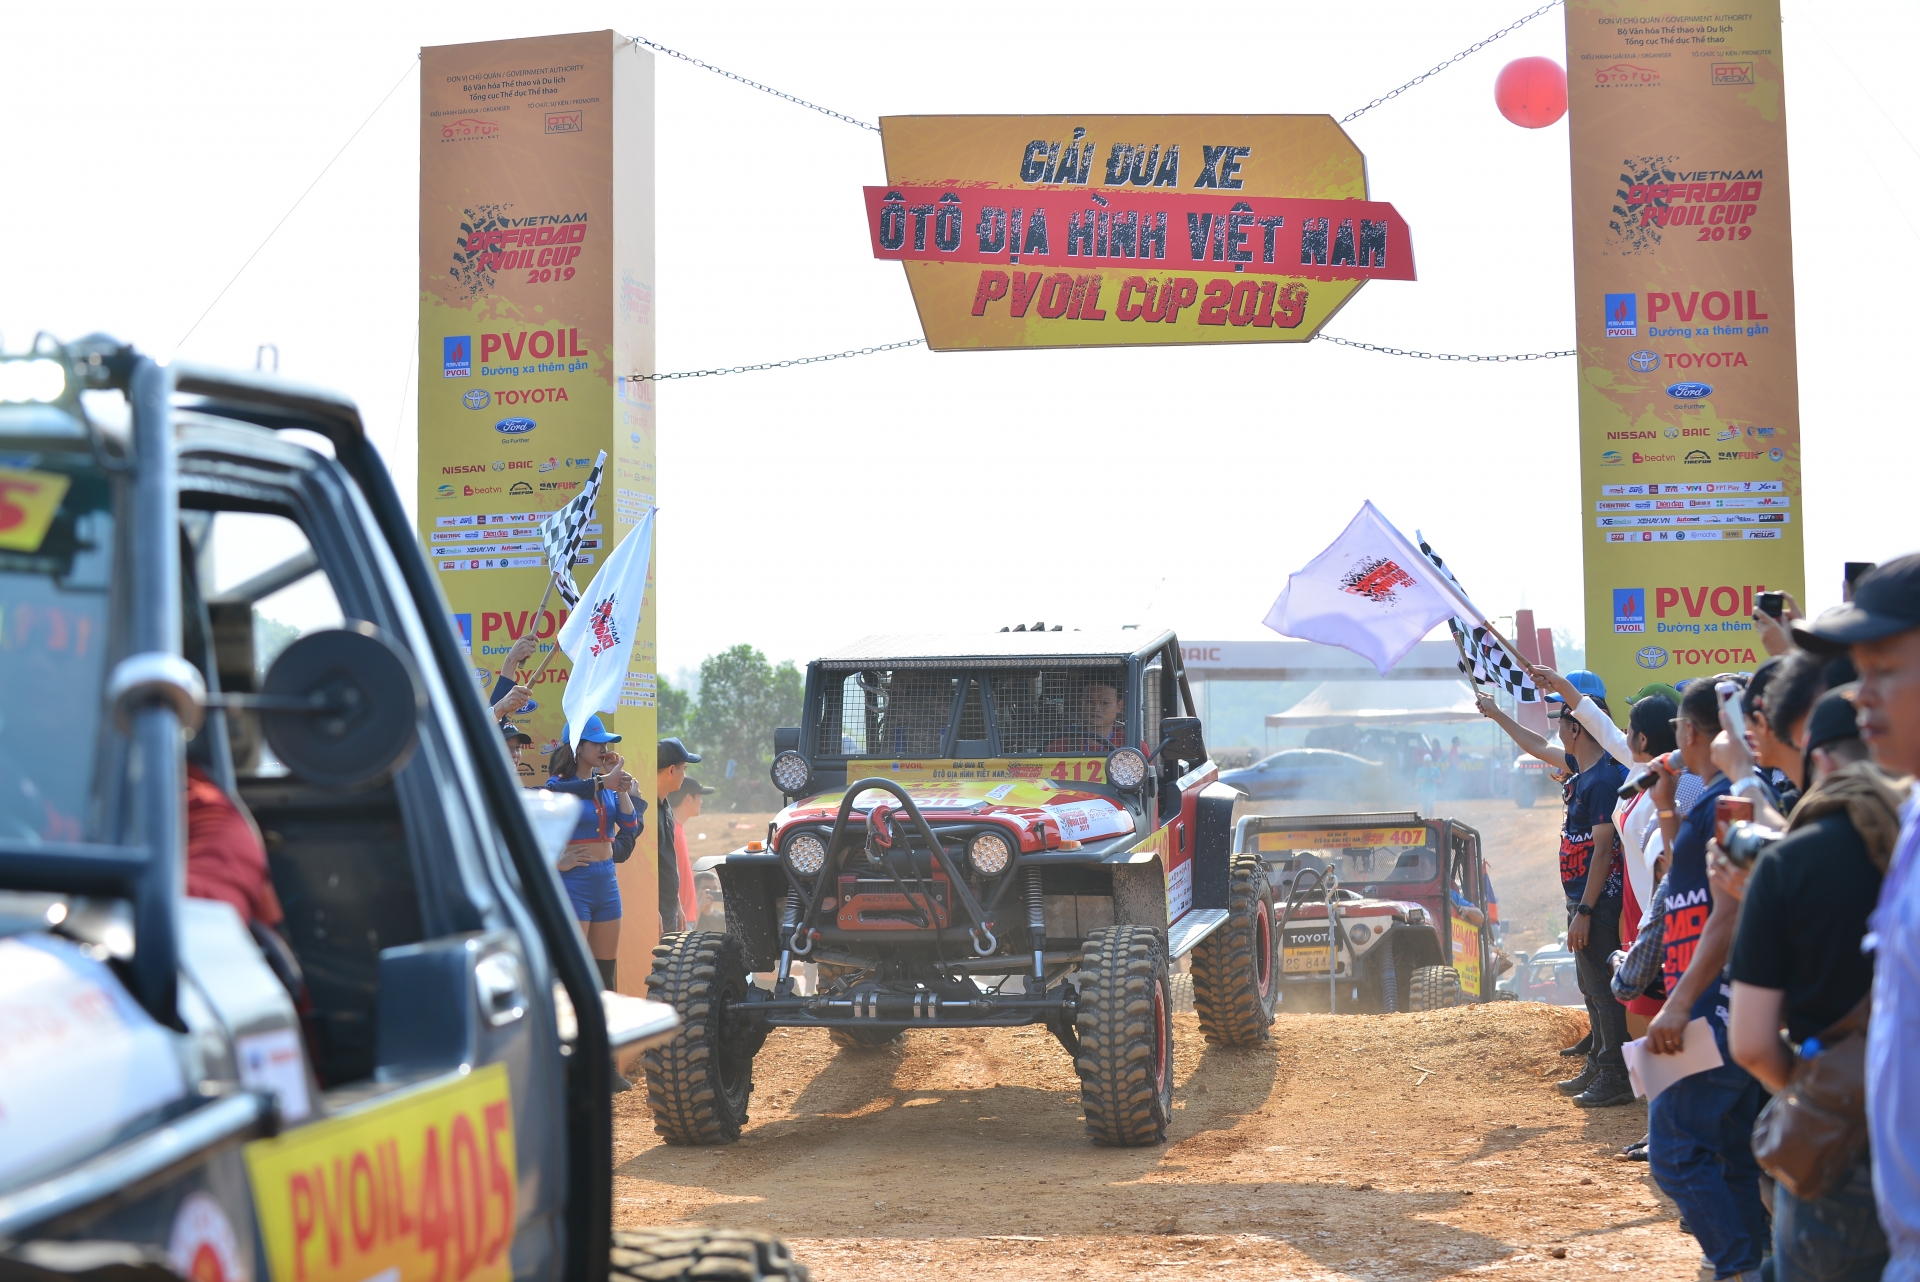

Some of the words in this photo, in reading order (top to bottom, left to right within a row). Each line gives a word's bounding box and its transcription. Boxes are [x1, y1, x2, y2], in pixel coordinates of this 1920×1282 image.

[1618, 28, 1627, 36] Bộ
[1629, 27, 1643, 35] Văn
[1677, 26, 1694, 34] thao
[1719, 25, 1732, 33] lịch
[506, 68, 548, 77] GOVERNMENT
[550, 65, 584, 73] AUTHORITY
[464, 84, 472, 92] Bộ
[473, 83, 486, 91] Văn
[515, 79, 531, 87] thao
[554, 76, 565, 85] lịch
[1020, 128, 1095, 186] GIẢI
[1105, 143, 1179, 188] ĐUA
[1194, 145, 1251, 190] XE
[1679, 170, 1763, 181] VIETNAM
[1626, 181, 1762, 204] OFFROAD
[512, 213, 588, 227] VIETNAM
[1640, 206, 1704, 226] PVOIL
[1708, 204, 1757, 225] CUP
[465, 224, 587, 250] OFFROAD
[878, 191, 962, 253] ÔTÔ
[976, 205, 1049, 264] ĐỊA
[1068, 194, 1167, 259] HÌNH
[1187, 202, 1283, 271] VIỆT
[1301, 217, 1388, 268] NAM
[1696, 226, 1752, 241] 2019
[477, 249, 535, 272] PVOIL
[537, 246, 581, 267] CUP
[526, 267, 576, 283] 2019
[972, 271, 1107, 321] PVOIL
[1116, 276, 1198, 323] CUP
[1197, 279, 1309, 328] 2019
[1647, 290, 1768, 322] PVOIL
[1649, 326, 1691, 338] Đường
[1695, 327, 1709, 335] xa
[1713, 324, 1743, 335] thêm
[1747, 322, 1769, 337] gần
[481, 328, 588, 363] PVOIL
[481, 366, 519, 377] Đường
[523, 363, 535, 373] xa
[538, 361, 564, 372] thêm
[568, 358, 588, 372] gần
[1664, 352, 1748, 368] TOYOTA
[446, 369, 468, 377] PVOIL
[495, 387, 568, 406] TOYOTA
[1675, 385, 1703, 397] Ford
[502, 418, 528, 432] Ford
[1682, 428, 1710, 437] BAIC
[1607, 431, 1656, 439] NISSAN
[442, 465, 485, 474] NISSAN
[509, 461, 533, 469] BAIC
[1616, 624, 1643, 632] PVOIL
[1657, 622, 1700, 634] Đường
[1704, 623, 1718, 631] xa
[1722, 620, 1752, 631] thêm
[1673, 649, 1757, 665] TOYOTA
[1051, 761, 1102, 783] 412
[1390, 830, 1423, 845] 407
